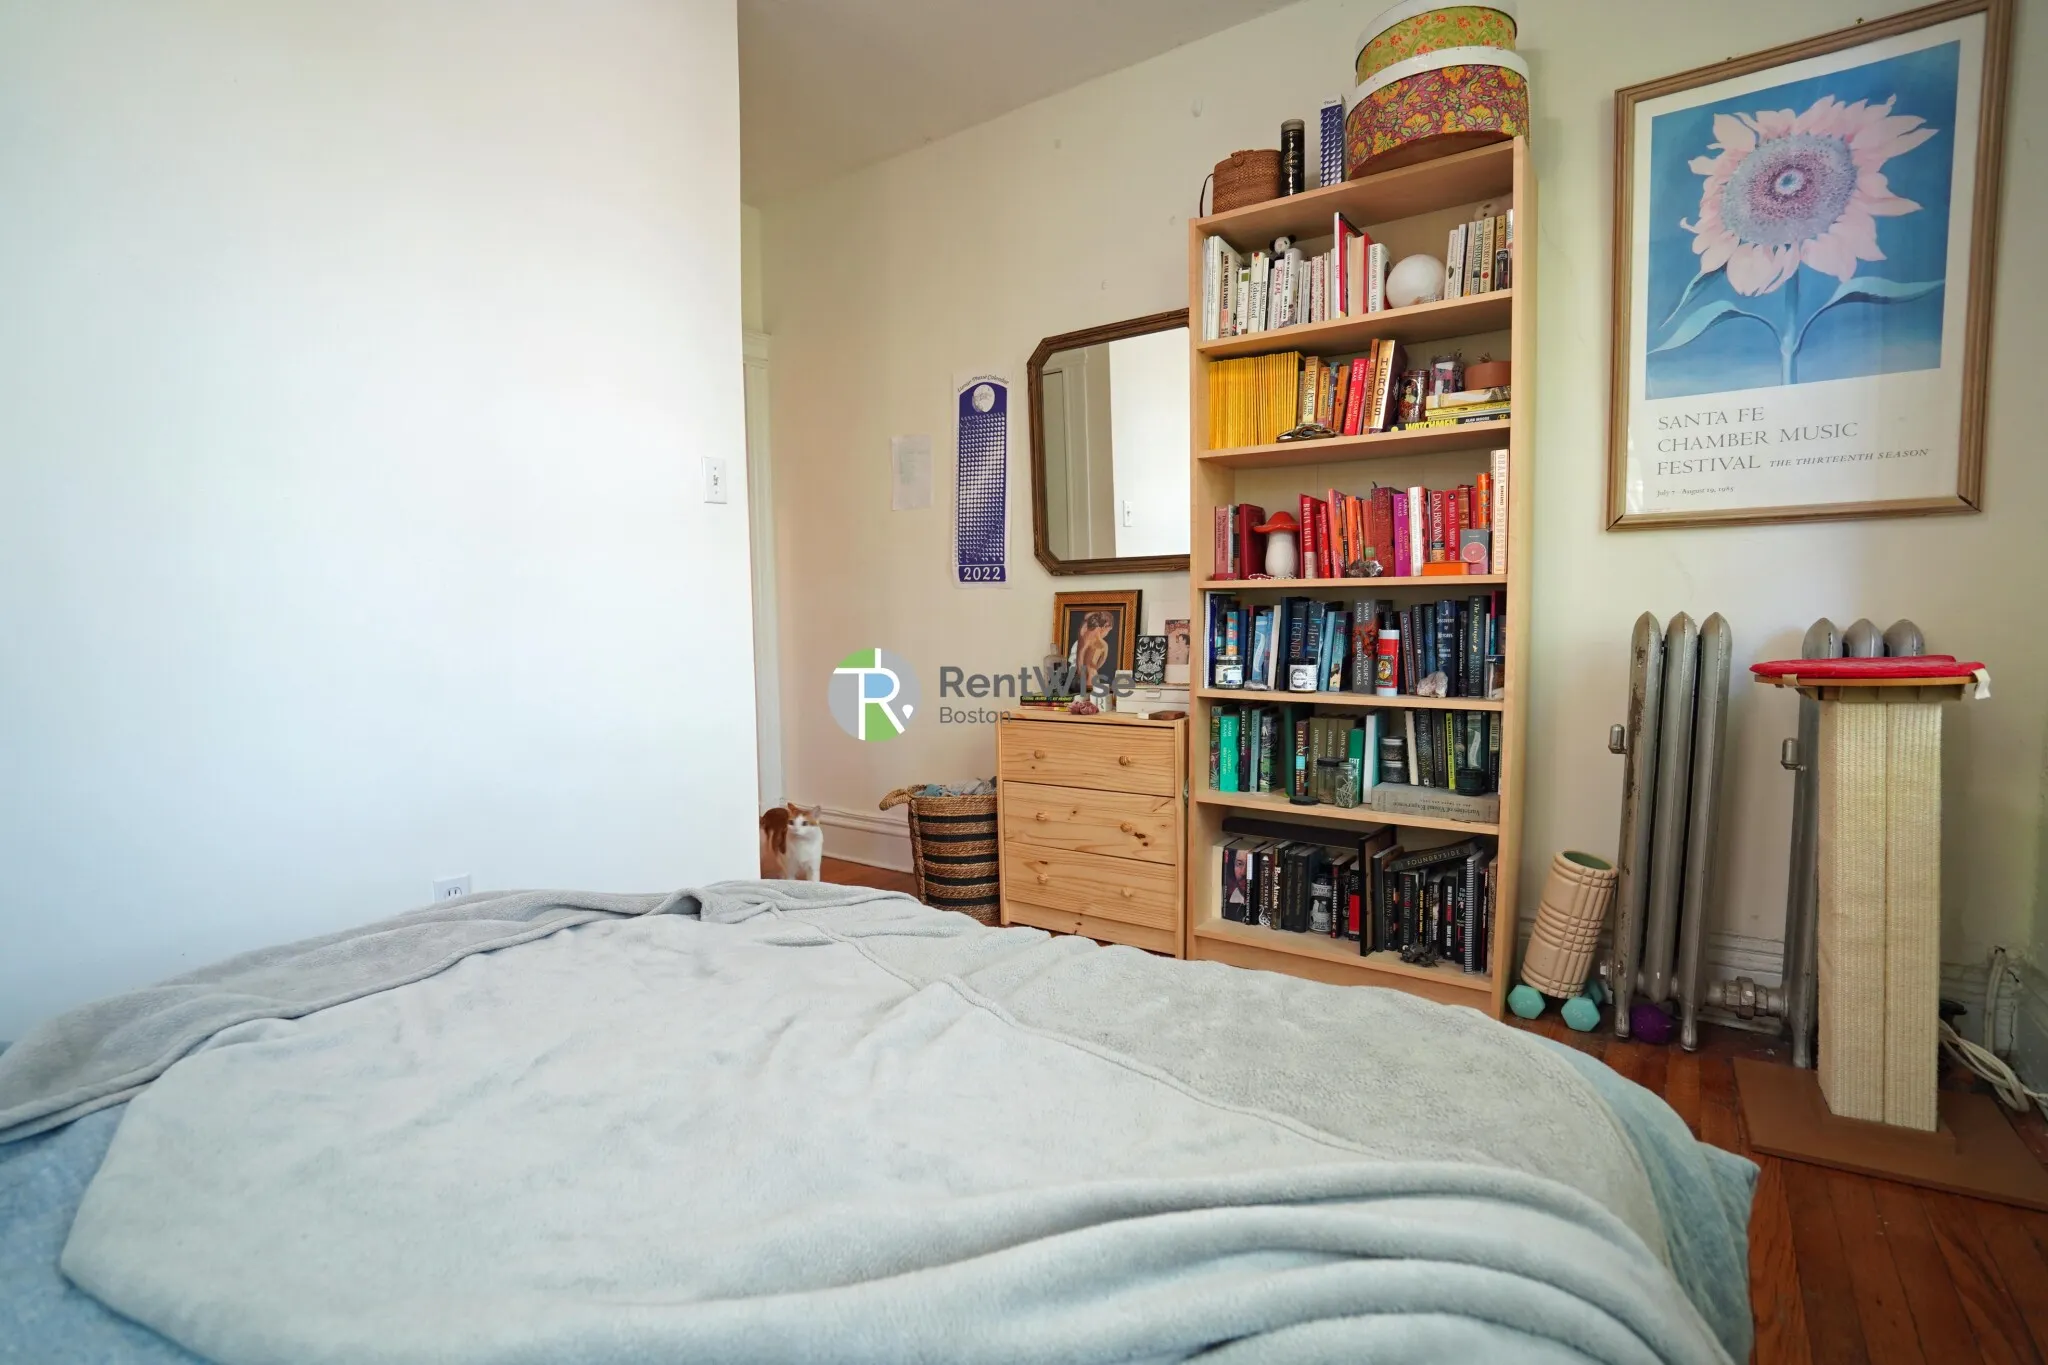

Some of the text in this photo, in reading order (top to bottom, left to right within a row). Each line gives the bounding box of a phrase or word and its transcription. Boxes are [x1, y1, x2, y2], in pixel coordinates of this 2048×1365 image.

[1251, 282, 1259, 318] Educated
[1374, 358, 1388, 416] HEROES
[1405, 418, 1458, 430] WATCHMEN
[1658, 406, 1765, 430] SANTA FE
[1657, 422, 1859, 453] CHAMBER MUSIC
[1497, 454, 1506, 484] OBAMA
[1657, 448, 1929, 476] FESTIVAL THE THIRTEENTH SEASON
[1656, 489, 1670, 498] July
[1682, 487, 1705, 496] August
[1433, 494, 1442, 542] DAN BROWN
[964, 567, 1001, 581] 2022
[1290, 617, 1302, 658] LEGENDB
[1392, 802, 1426, 810] Experience
[1454, 808, 1480, 816] Varieties
[1407, 850, 1460, 866] FOUNDRYSIDE
